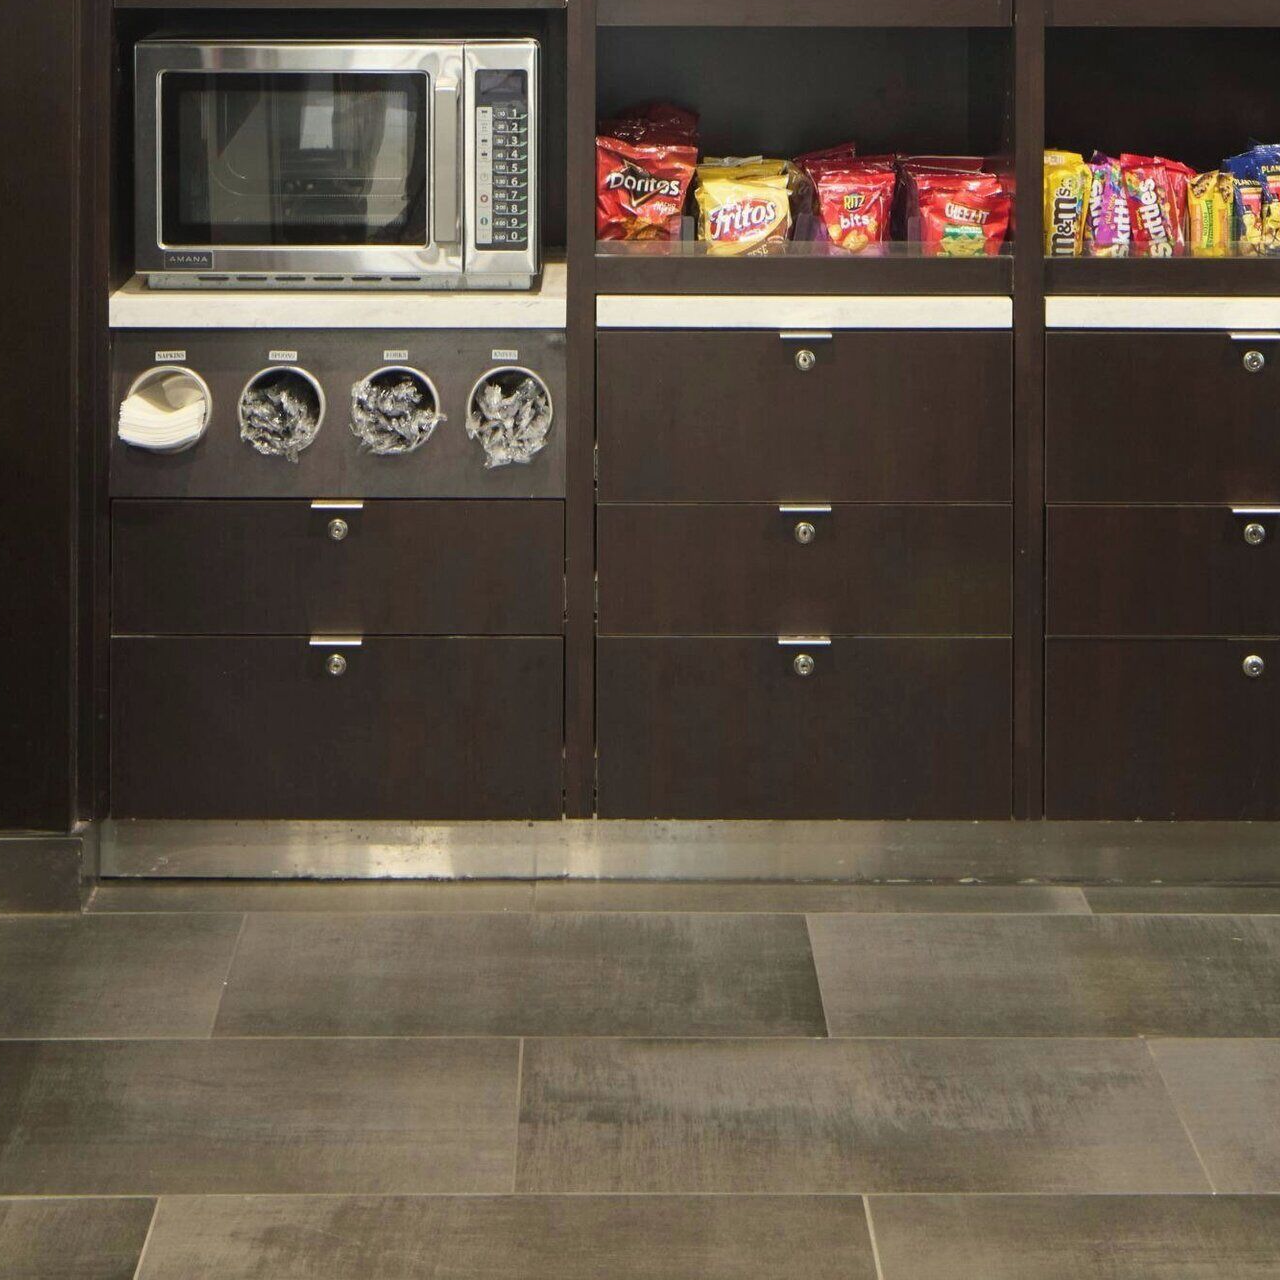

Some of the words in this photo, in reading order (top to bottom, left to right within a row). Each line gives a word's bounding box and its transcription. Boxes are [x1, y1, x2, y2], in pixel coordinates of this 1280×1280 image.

[512, 109, 517, 117] 1
[512, 123, 518, 131] 2
[512, 136, 518, 145] 3
[511, 150, 518, 158] 4
[511, 164, 518, 172] 5
[511, 177, 518, 186] 6
[606, 172, 680, 196] Doritos
[511, 191, 518, 199] 7
[843, 194, 866, 211] RITZ
[511, 204, 518, 213] 8
[511, 218, 518, 226] 9
[709, 199, 777, 240] Fritos
[840, 213, 871, 230] bits
[1111, 188, 1131, 257] Skittl
[511, 231, 518, 240] 0
